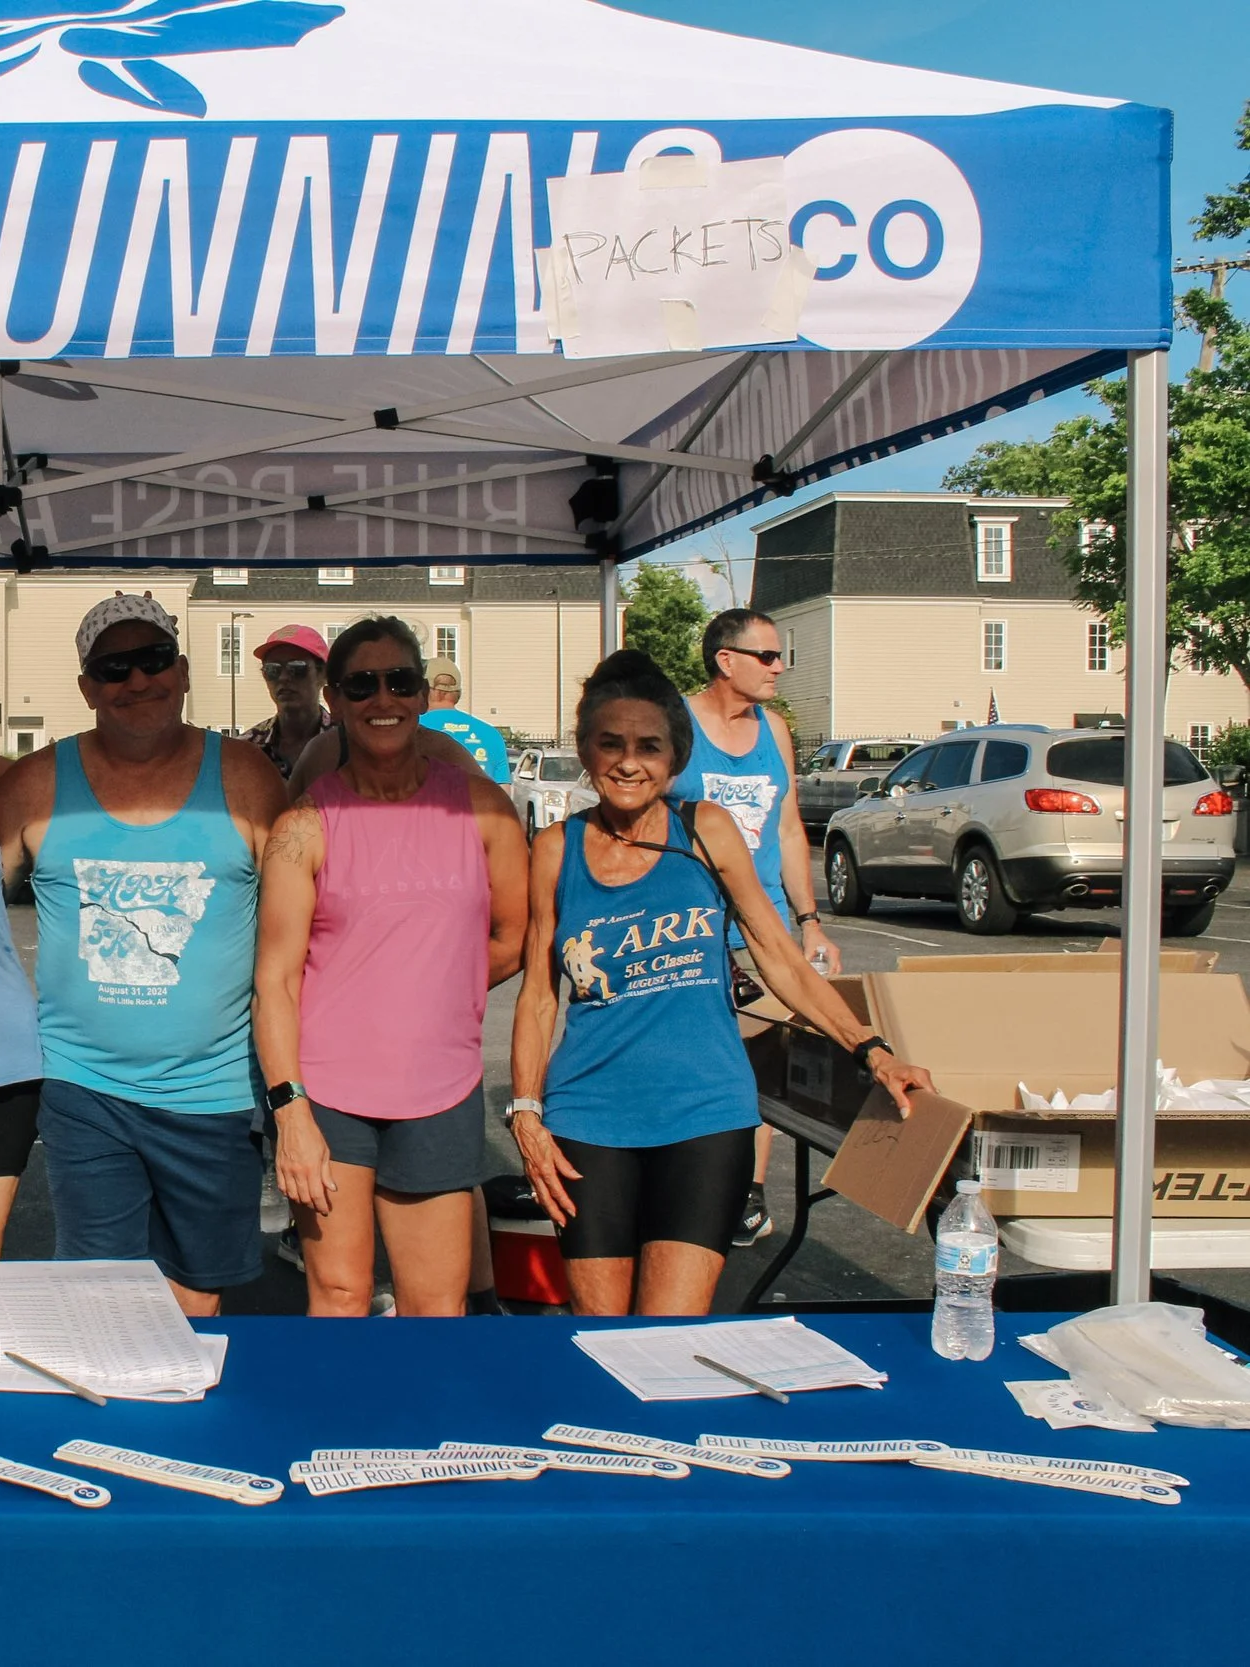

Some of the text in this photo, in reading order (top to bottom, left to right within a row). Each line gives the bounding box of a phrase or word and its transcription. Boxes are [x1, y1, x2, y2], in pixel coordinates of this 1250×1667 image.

[562, 216, 785, 285] PACKETS
[790, 198, 945, 282] CO
[607, 908, 647, 925] Annual
[612, 907, 718, 958] ARK
[624, 948, 704, 980] 5K Classic
[98, 984, 168, 997] August 31, 2024
[626, 974, 667, 990] AUGUST
[681, 968, 702, 978] 2019
[98, 996, 116, 1004] North
[117, 996, 134, 1006] Little
[157, 998, 168, 1006] AR
[316, 1451, 365, 1461] BLUE
[370, 1450, 421, 1460] ROSE
[425, 1450, 519, 1460] RUNNING
[552, 1426, 601, 1440] BLUE
[604, 1432, 657, 1448] ROSE
[661, 1442, 754, 1467] RUNNING
[706, 1436, 754, 1448] BLUE
[760, 1440, 813, 1453] ROSE
[816, 1442, 912, 1453] RUNNING
[64, 1441, 112, 1458] BLUE
[110, 1450, 161, 1469] ROSE
[158, 1462, 252, 1485] RUNNING
[310, 1470, 362, 1492] BLUE
[366, 1466, 417, 1484] ROSE
[420, 1460, 512, 1479] RUNNING
[986, 1452, 1040, 1467] ROSE
[1046, 1459, 1150, 1478] RUNNING
